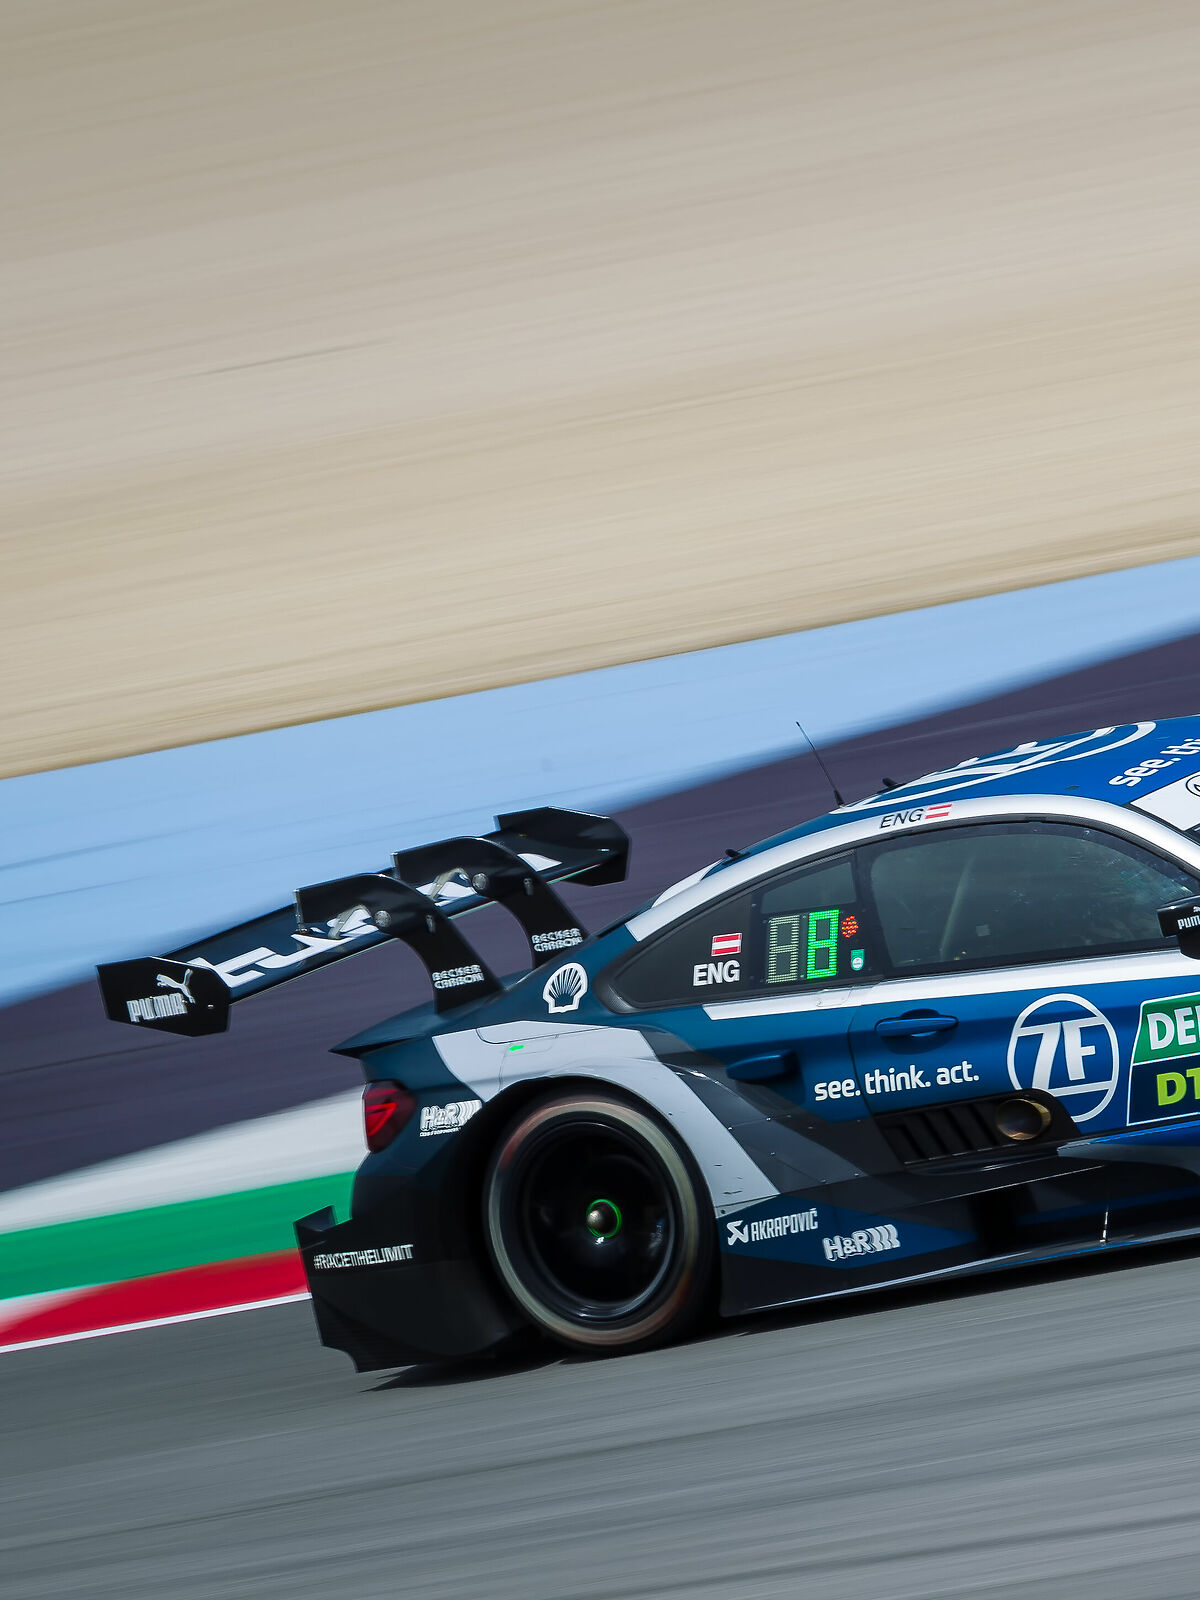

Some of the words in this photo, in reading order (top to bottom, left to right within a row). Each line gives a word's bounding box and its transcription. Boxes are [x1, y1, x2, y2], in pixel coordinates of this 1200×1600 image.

[1109, 758, 1181, 787] see.
[880, 808, 922, 829] ENG
[532, 928, 581, 944] BECKER
[534, 937, 584, 952] CARBON
[432, 965, 481, 981] BECKER
[434, 973, 485, 989] CARBON
[693, 960, 741, 987] ENG
[126, 992, 188, 1023] PUMA
[1016, 1014, 1114, 1100] ZF
[814, 1079, 861, 1101] see.
[864, 1064, 932, 1095] think.
[936, 1060, 979, 1086] act.
[823, 1224, 900, 1262] H&R
[313, 1244, 414, 1270] #RACETHELIMIT
